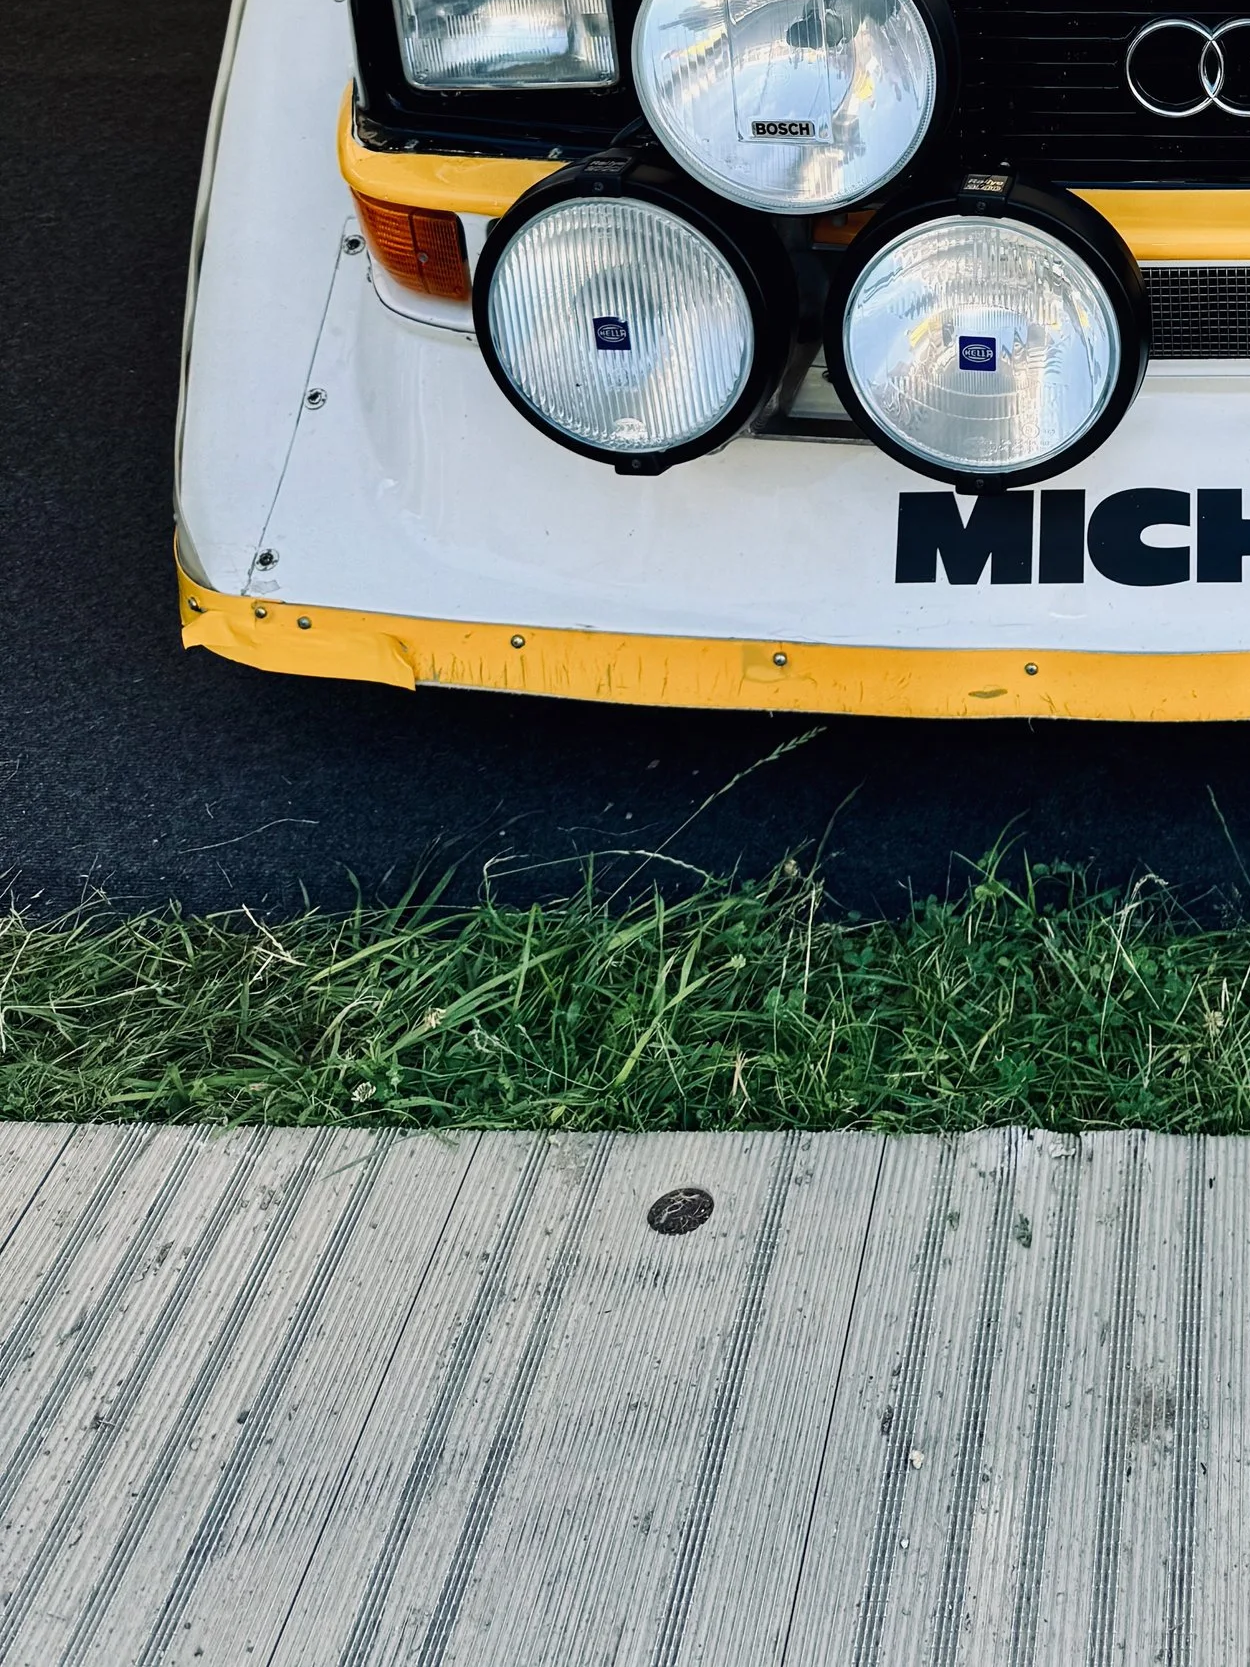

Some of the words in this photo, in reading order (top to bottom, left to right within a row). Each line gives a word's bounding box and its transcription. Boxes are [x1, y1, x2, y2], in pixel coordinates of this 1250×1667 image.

[755, 122, 811, 136] BOSCH
[599, 327, 628, 339] HELLA
[963, 346, 994, 360] HELLA
